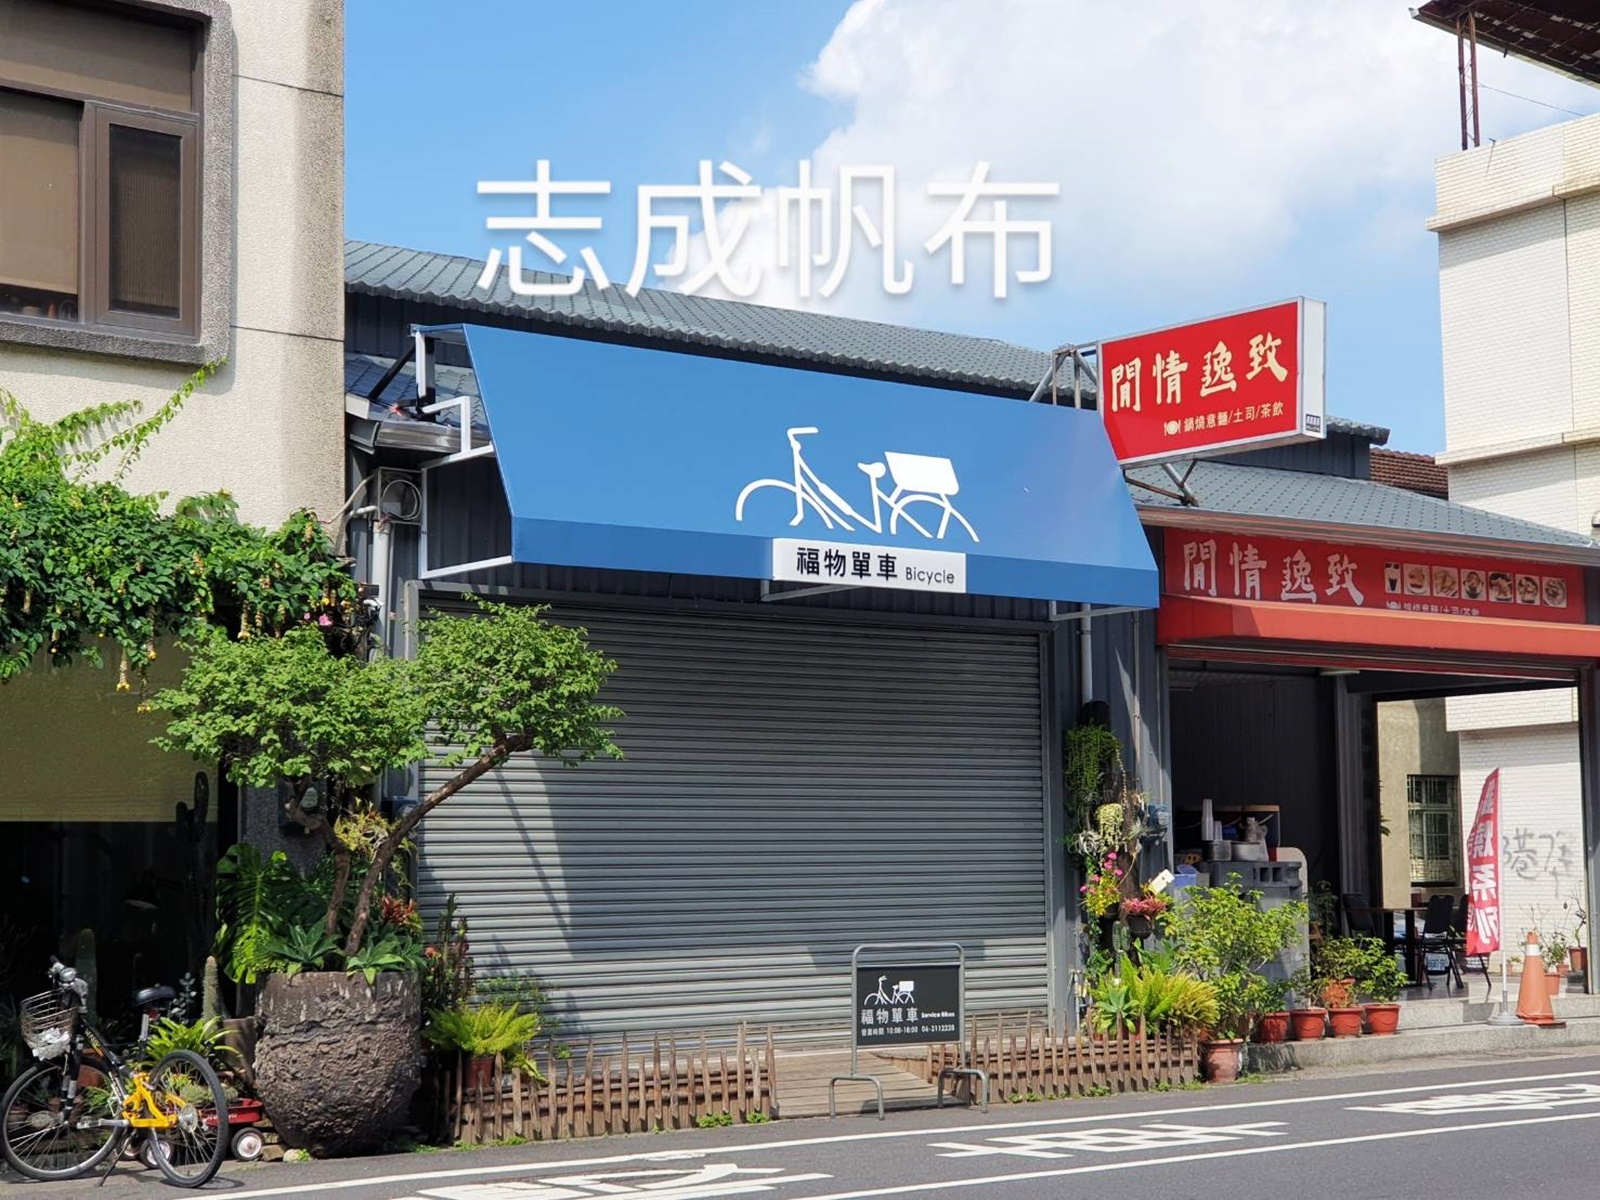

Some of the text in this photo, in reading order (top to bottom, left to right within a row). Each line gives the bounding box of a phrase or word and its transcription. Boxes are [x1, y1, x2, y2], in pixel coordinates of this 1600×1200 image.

[796, 546, 955, 585] 福物單車 Bicycle
[861, 1007, 918, 1025] 福物單車
